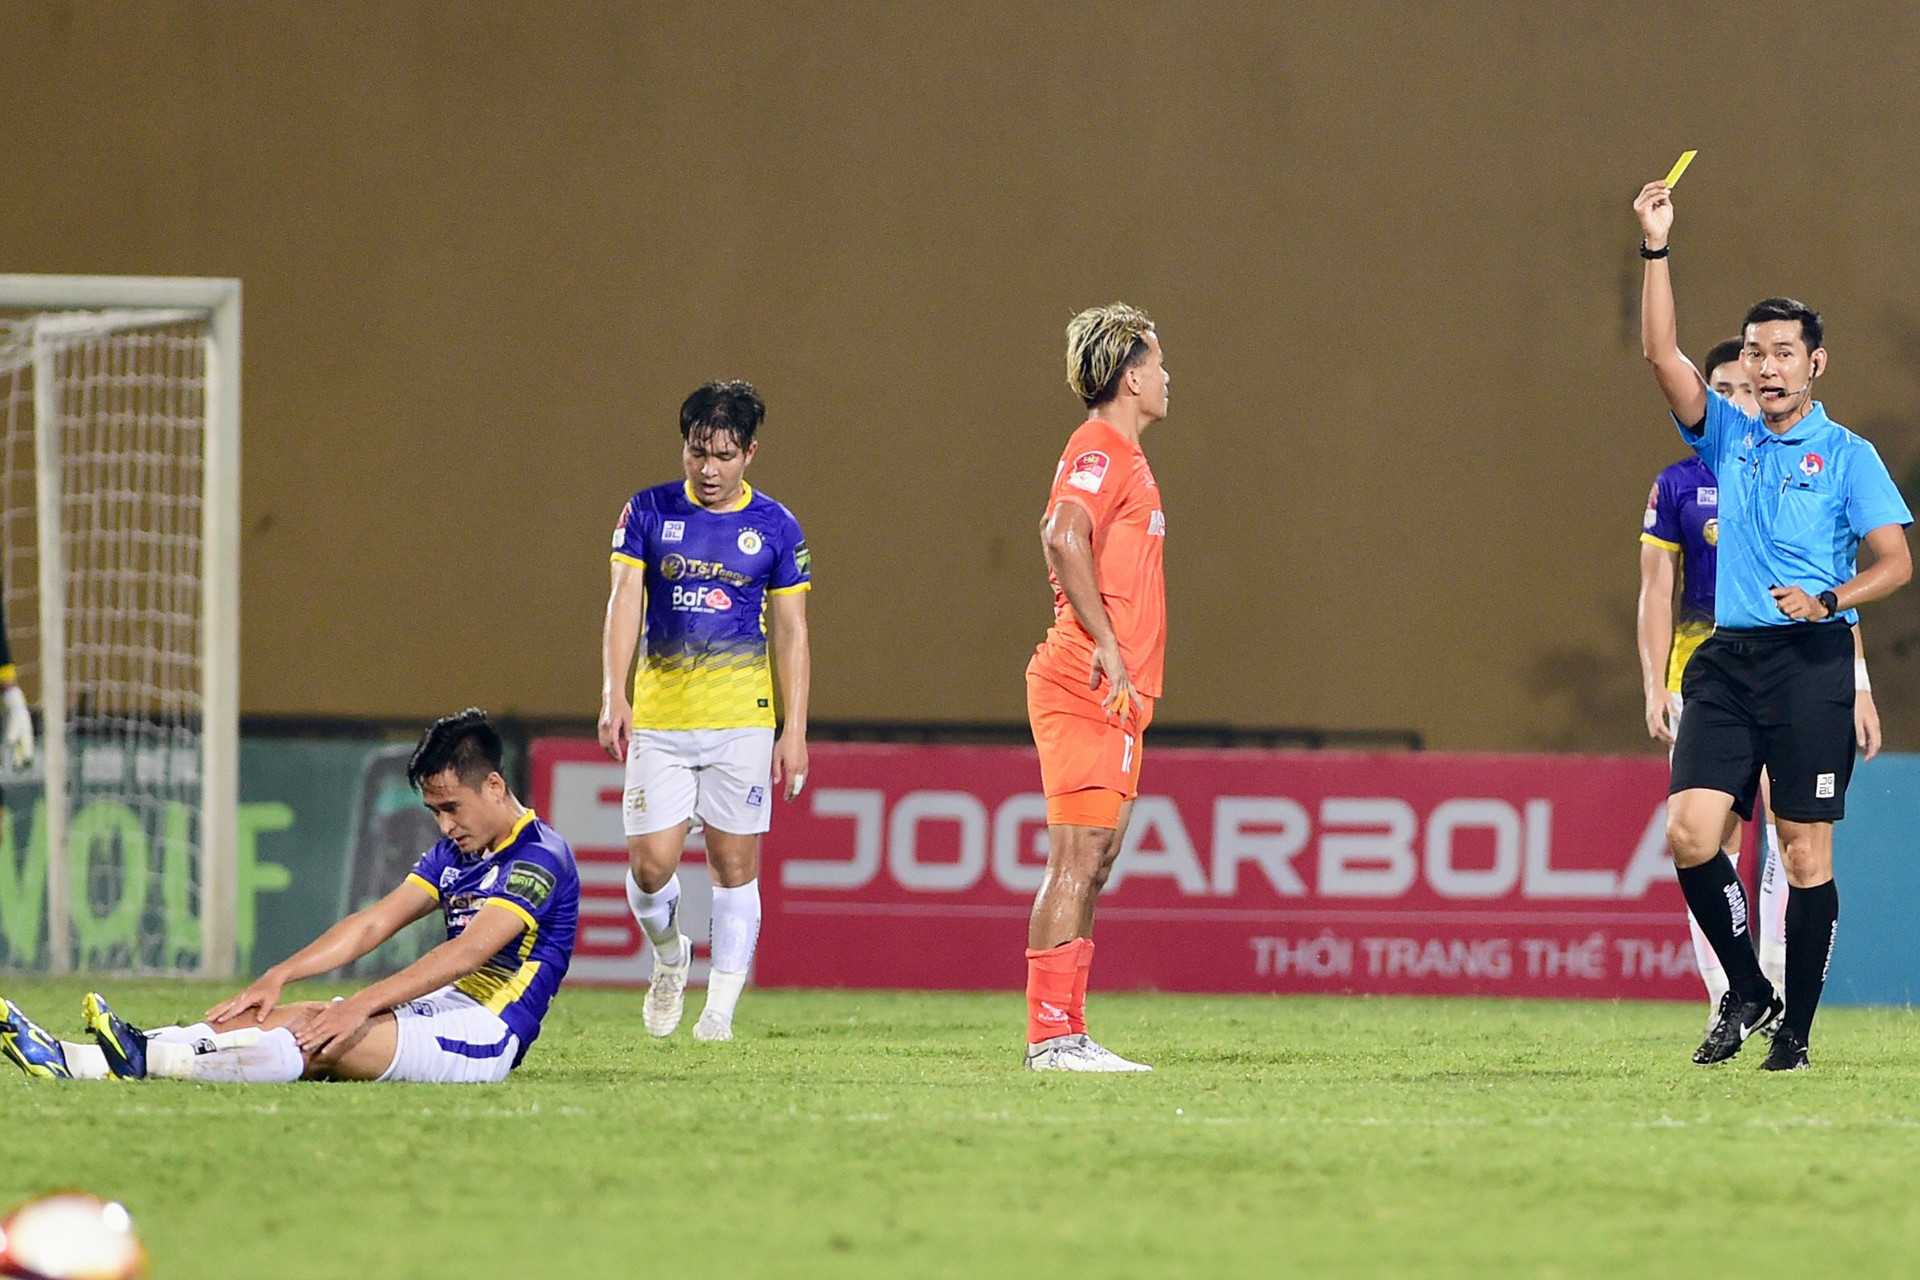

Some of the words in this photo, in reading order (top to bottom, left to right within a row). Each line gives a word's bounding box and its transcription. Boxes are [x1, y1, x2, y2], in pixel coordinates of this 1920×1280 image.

[672, 585, 709, 607] BaF
[1363, 937, 1512, 979] TRANG
[1615, 937, 1700, 979] THA
